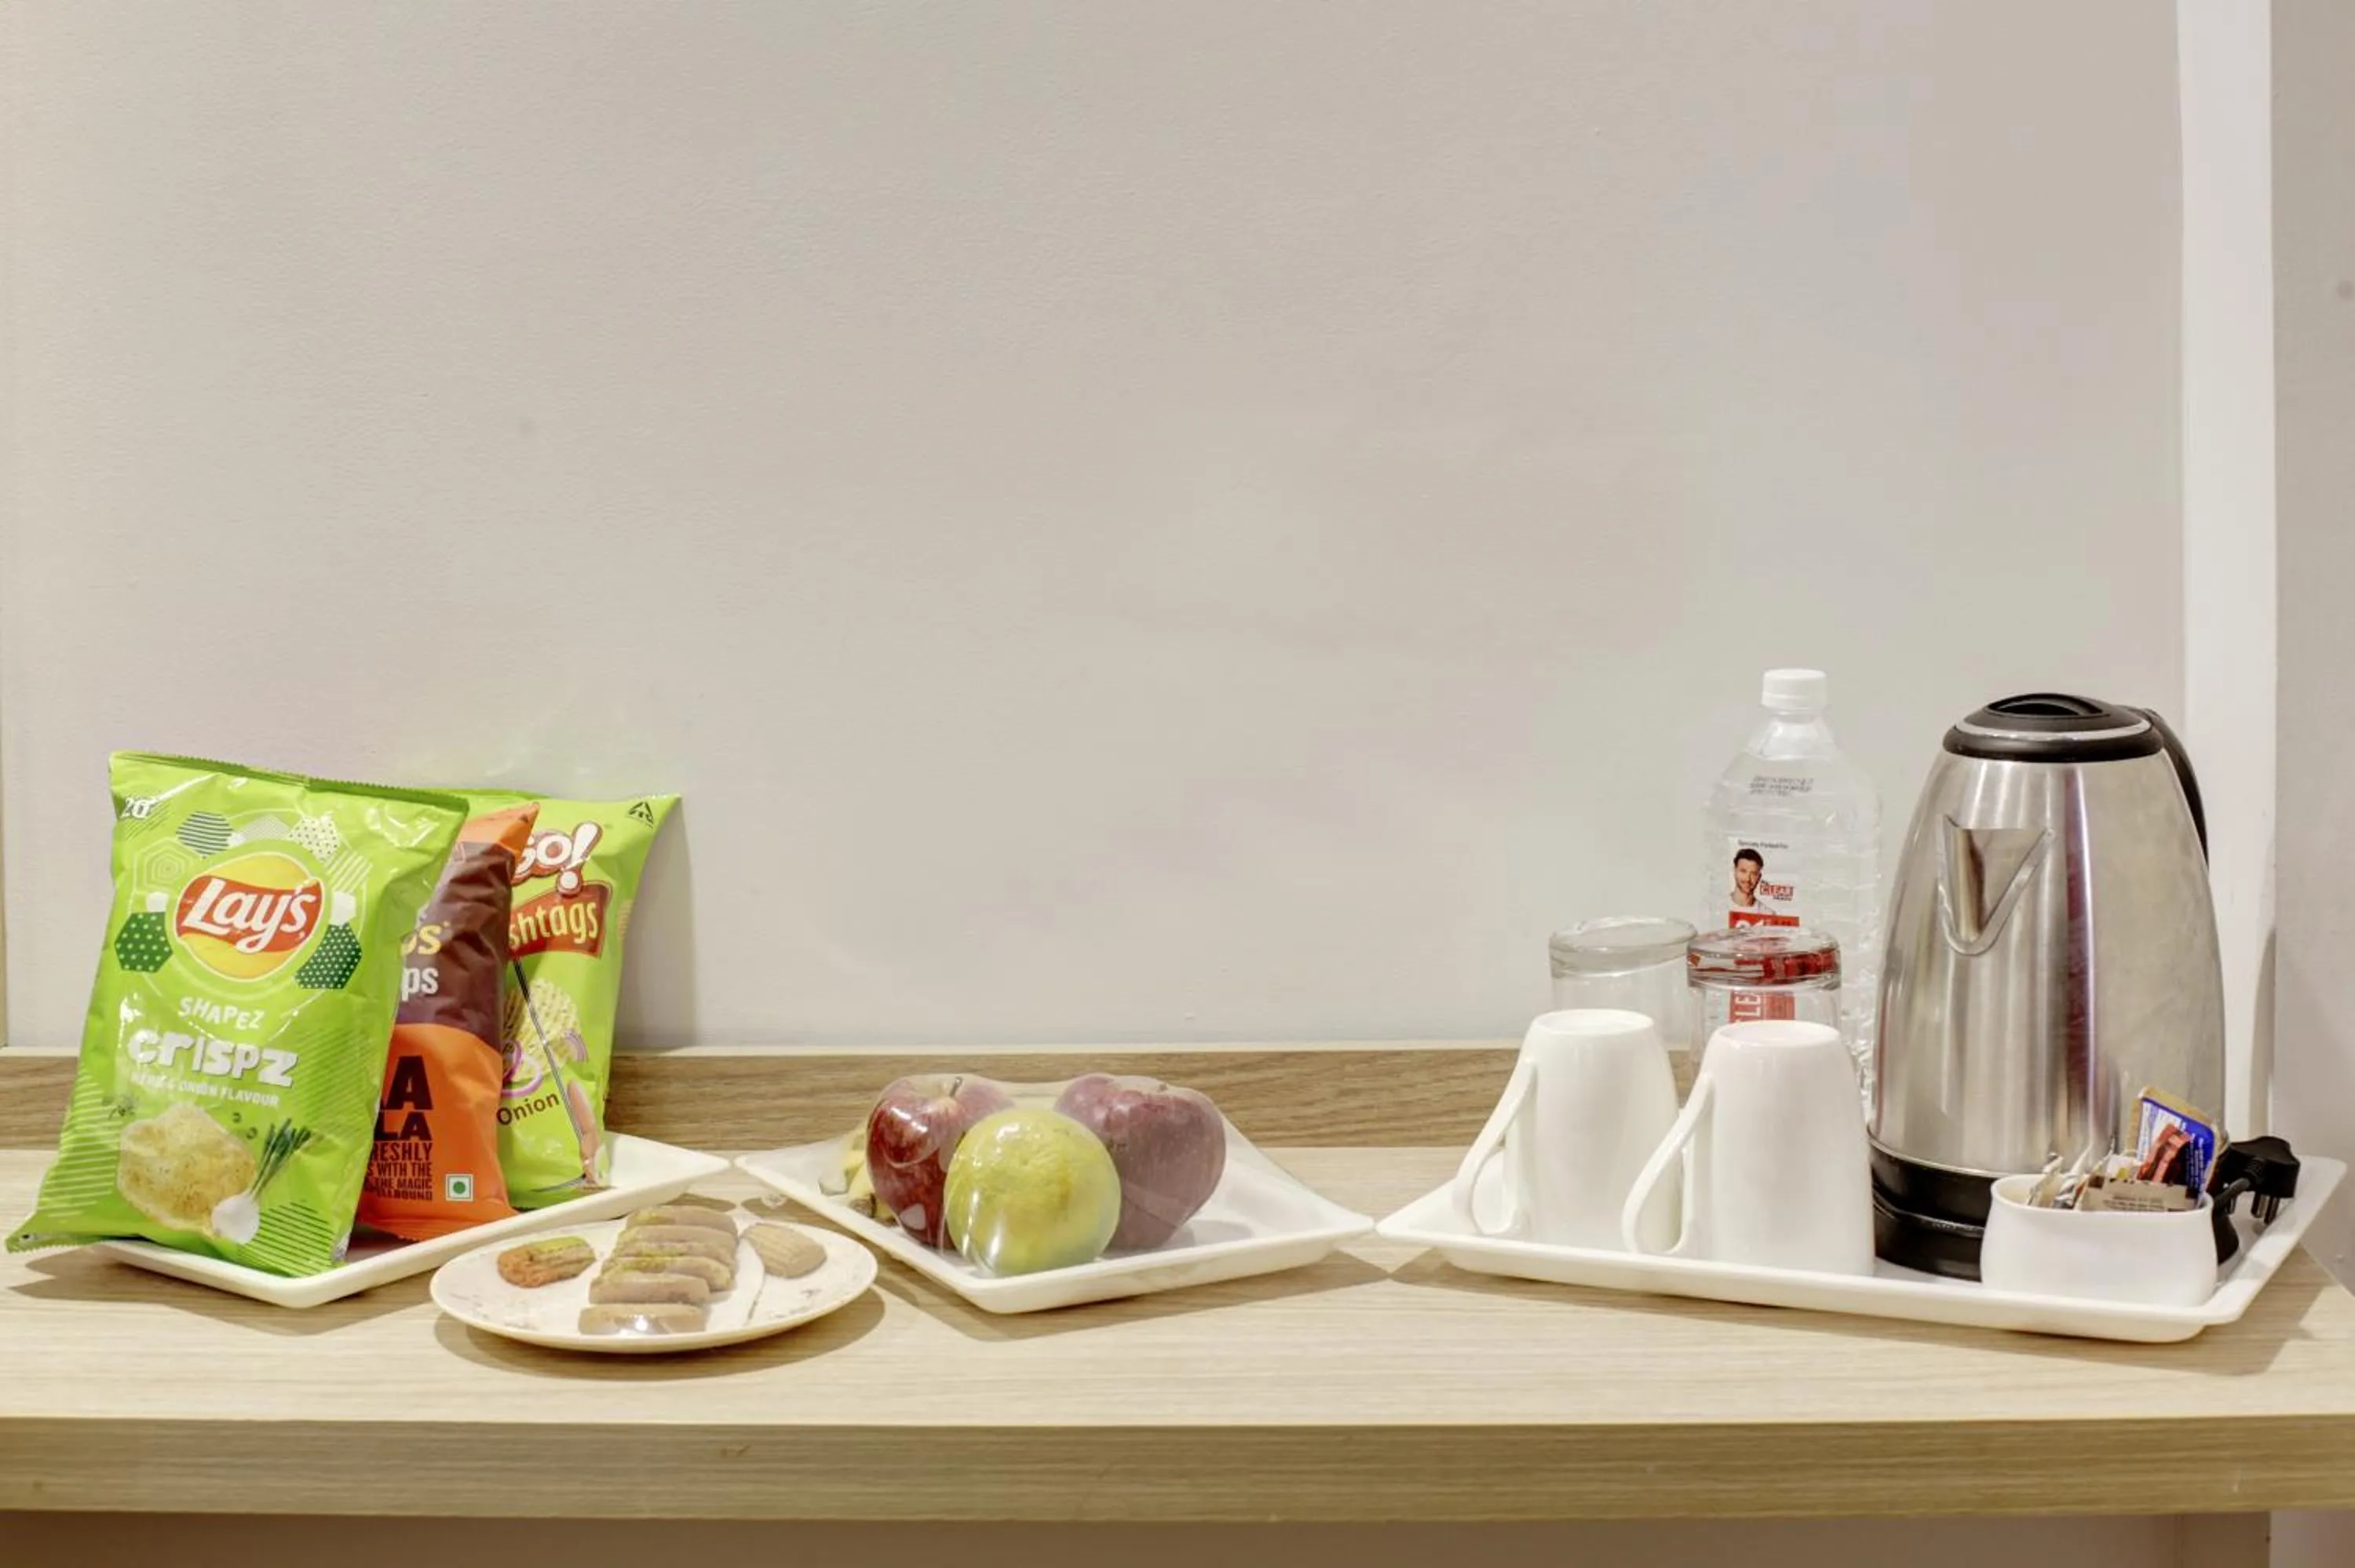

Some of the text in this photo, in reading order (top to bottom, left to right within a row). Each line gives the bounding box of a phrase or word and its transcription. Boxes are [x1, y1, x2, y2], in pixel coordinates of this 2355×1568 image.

[181, 877, 318, 955] Lay's
[178, 997, 265, 1031] SHAPEZ
[221, 1086, 280, 1107] FLAVOUR
[496, 1092, 560, 1126] Onion
[377, 1162, 407, 1177] WITH
[411, 1162, 433, 1177] THE
[396, 1178, 433, 1190] MAGIC
